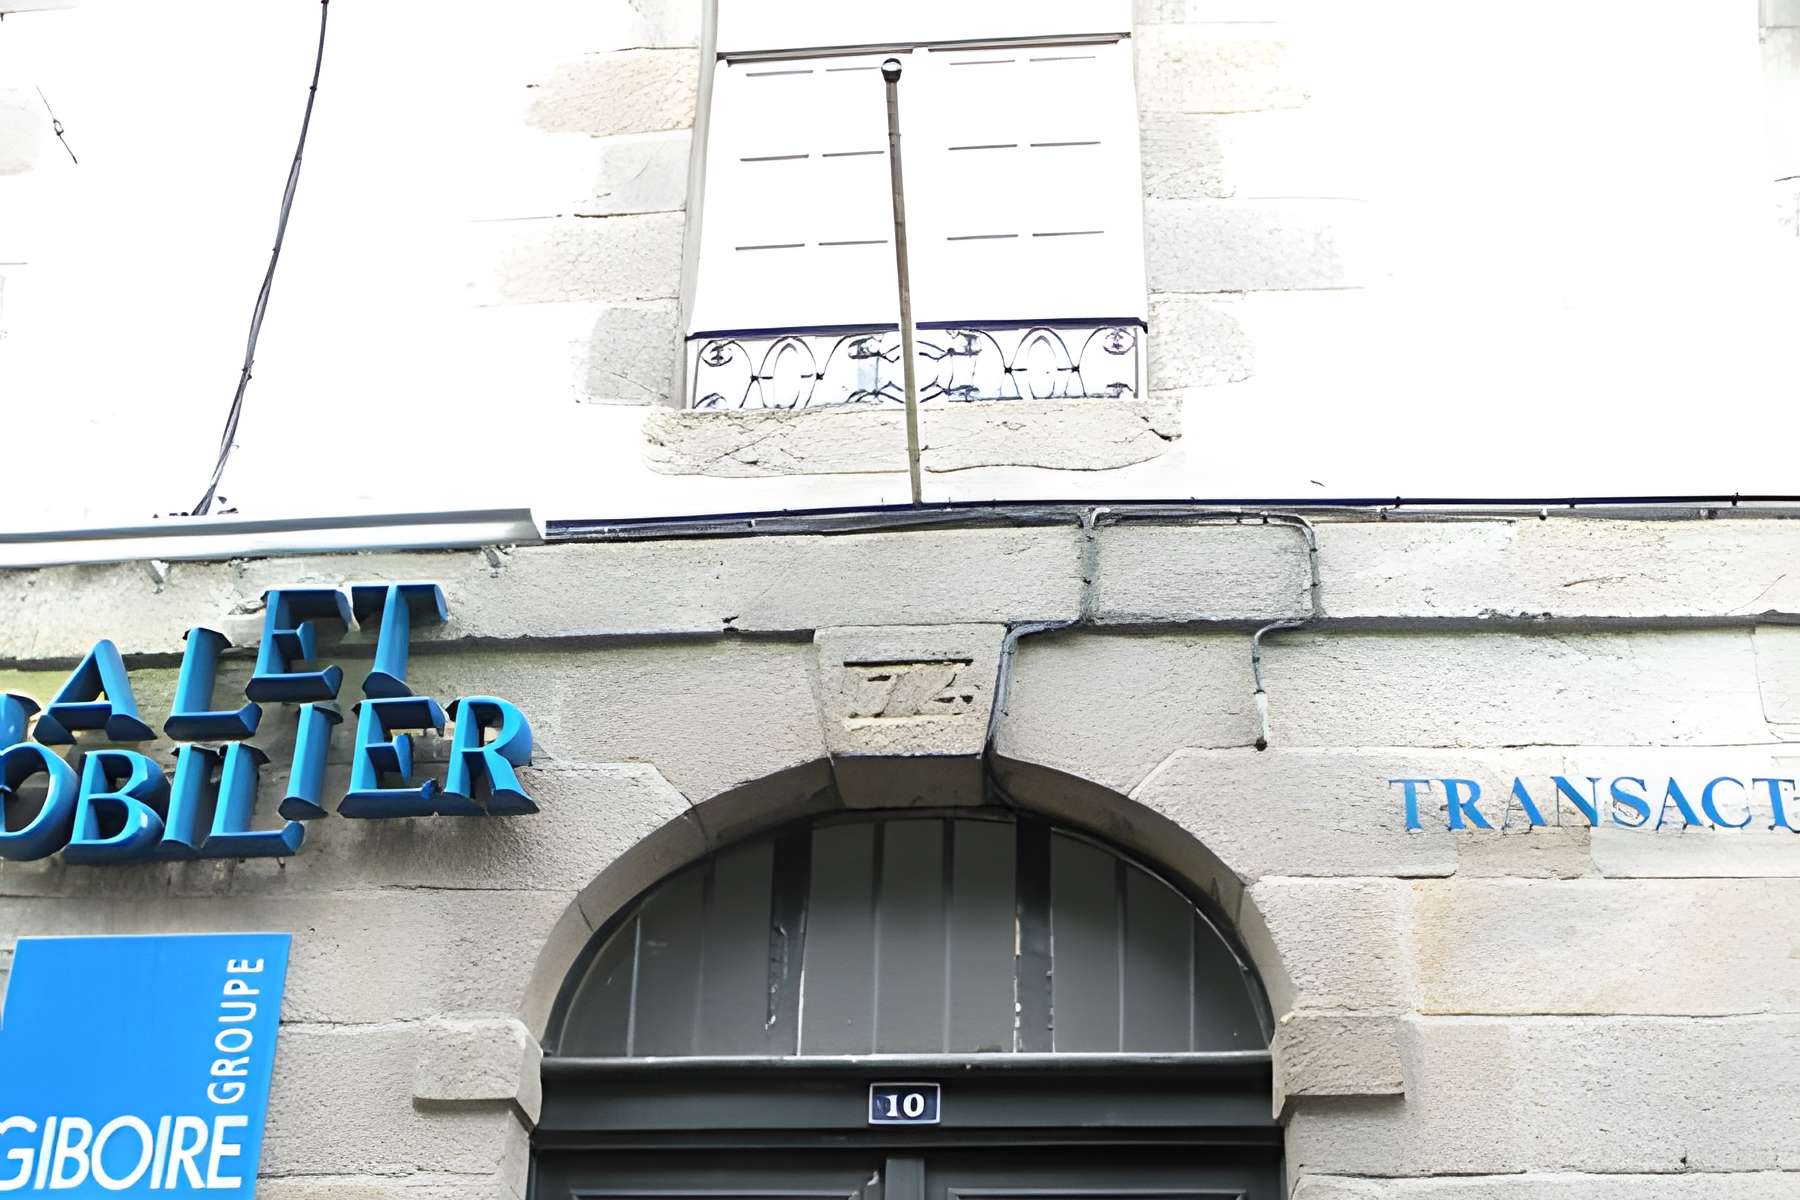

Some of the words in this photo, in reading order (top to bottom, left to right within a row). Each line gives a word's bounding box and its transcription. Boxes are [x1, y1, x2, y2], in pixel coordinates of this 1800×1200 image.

[1388, 776, 1797, 832] TRANSACT
[207, 958, 264, 1104] GROUPE
[884, 1093, 925, 1118] 10
[0, 1115, 249, 1191] GIBOIRE
